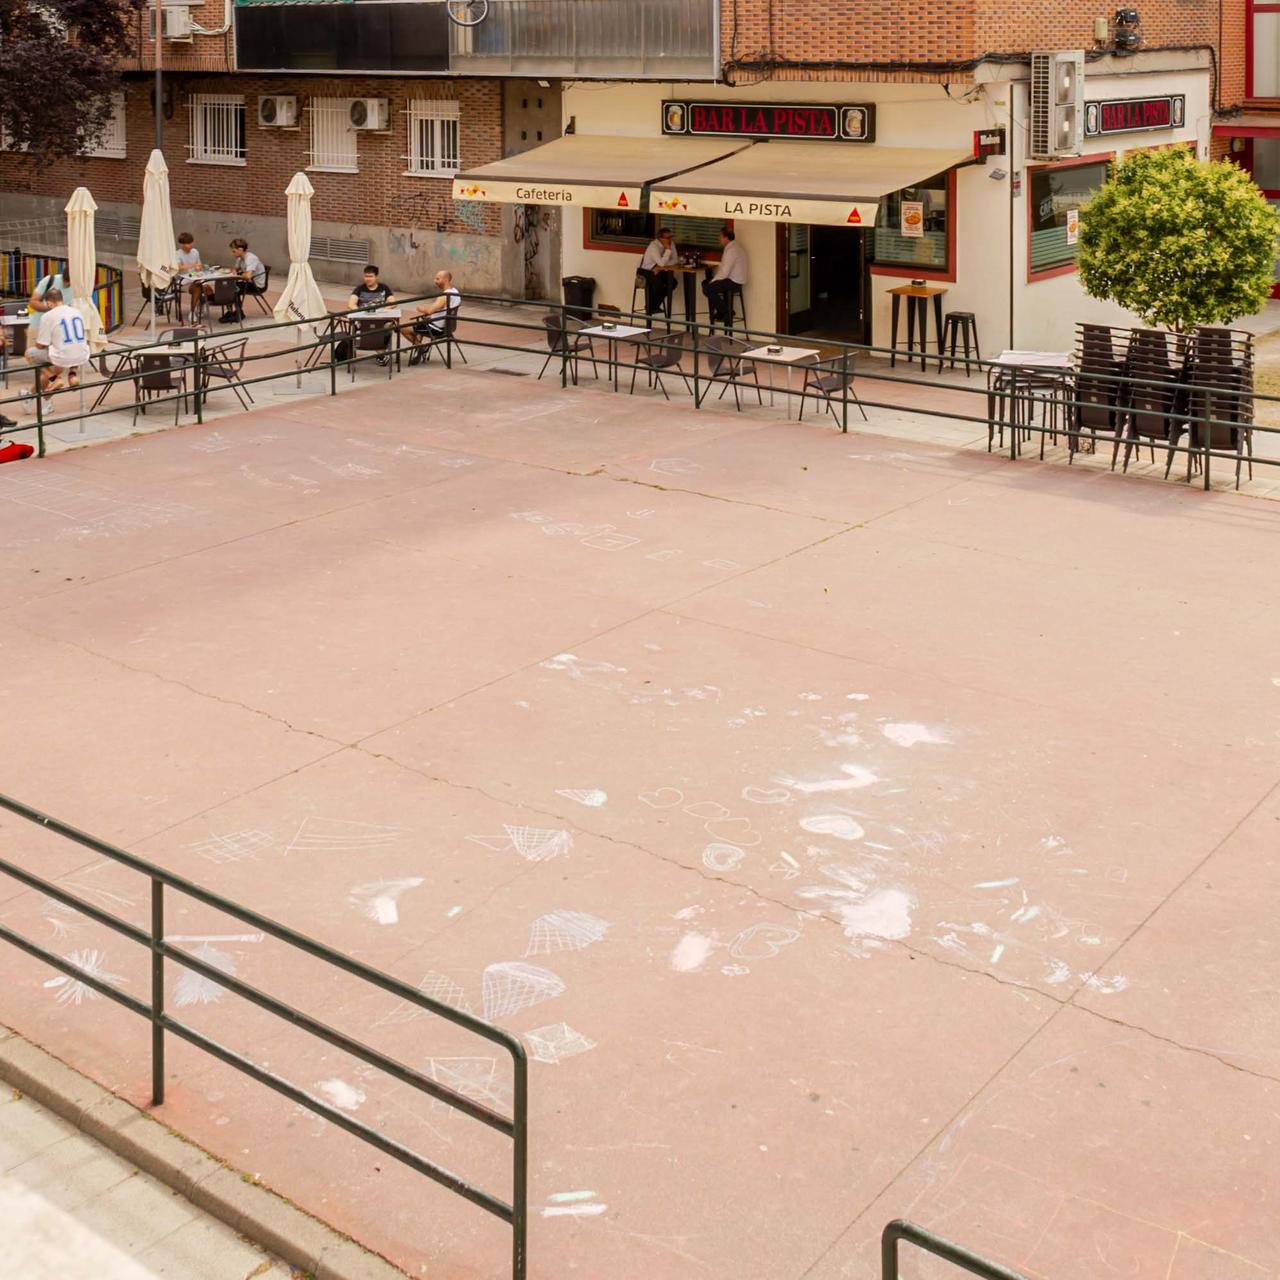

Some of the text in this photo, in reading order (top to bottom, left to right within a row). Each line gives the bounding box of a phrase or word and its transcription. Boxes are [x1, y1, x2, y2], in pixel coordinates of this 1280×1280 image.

[693, 106, 832, 135] BAR LA PISTA
[1102, 100, 1169, 130] BAR LA PISTA
[724, 201, 792, 217] LA PISTA
[59, 316, 86, 345] 10
